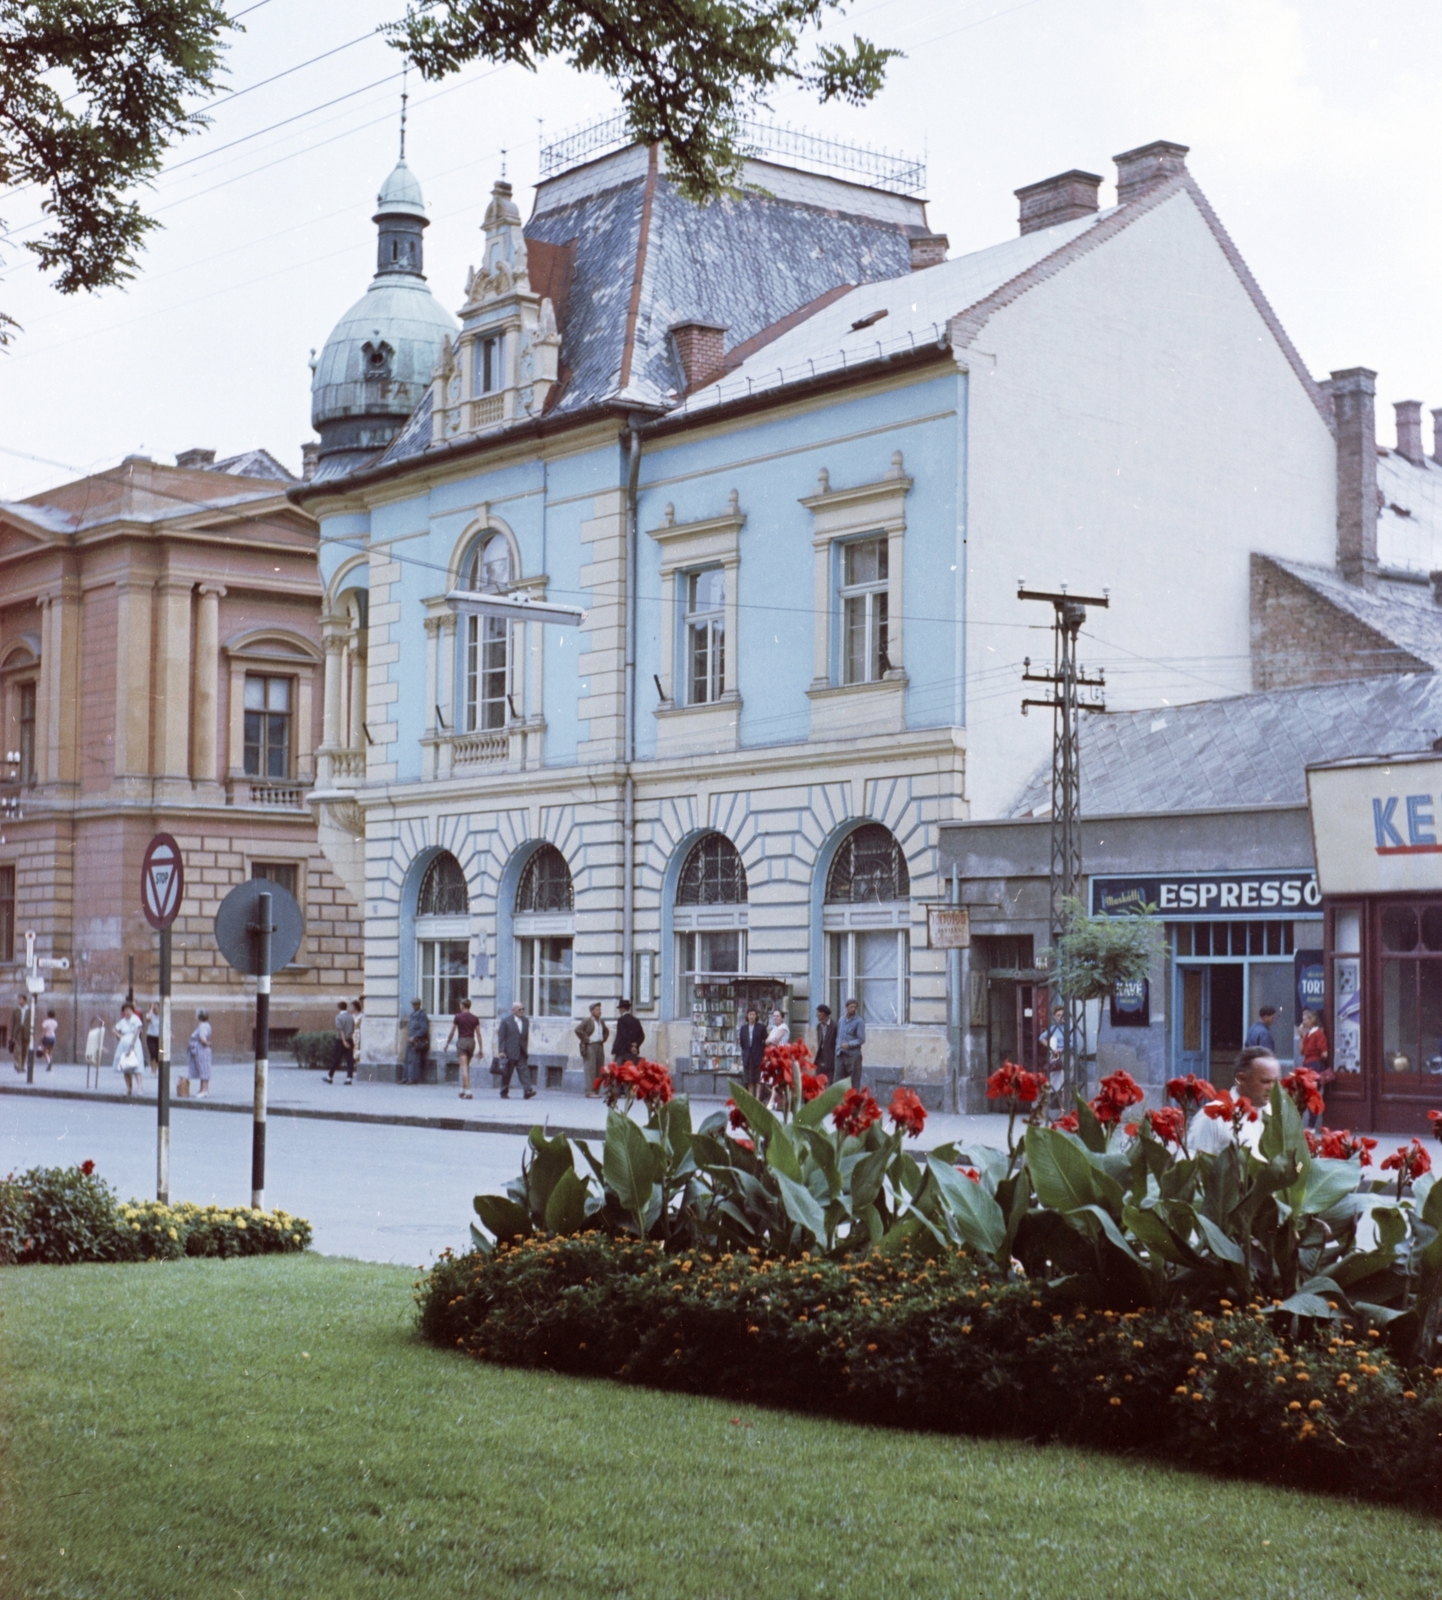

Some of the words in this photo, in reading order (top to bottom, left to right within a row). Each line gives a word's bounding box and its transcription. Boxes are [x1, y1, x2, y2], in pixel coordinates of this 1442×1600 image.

[1372, 795, 1442, 848] KE
[155, 871, 169, 885] STOP
[1160, 874, 1323, 908] ESPRESSÓ
